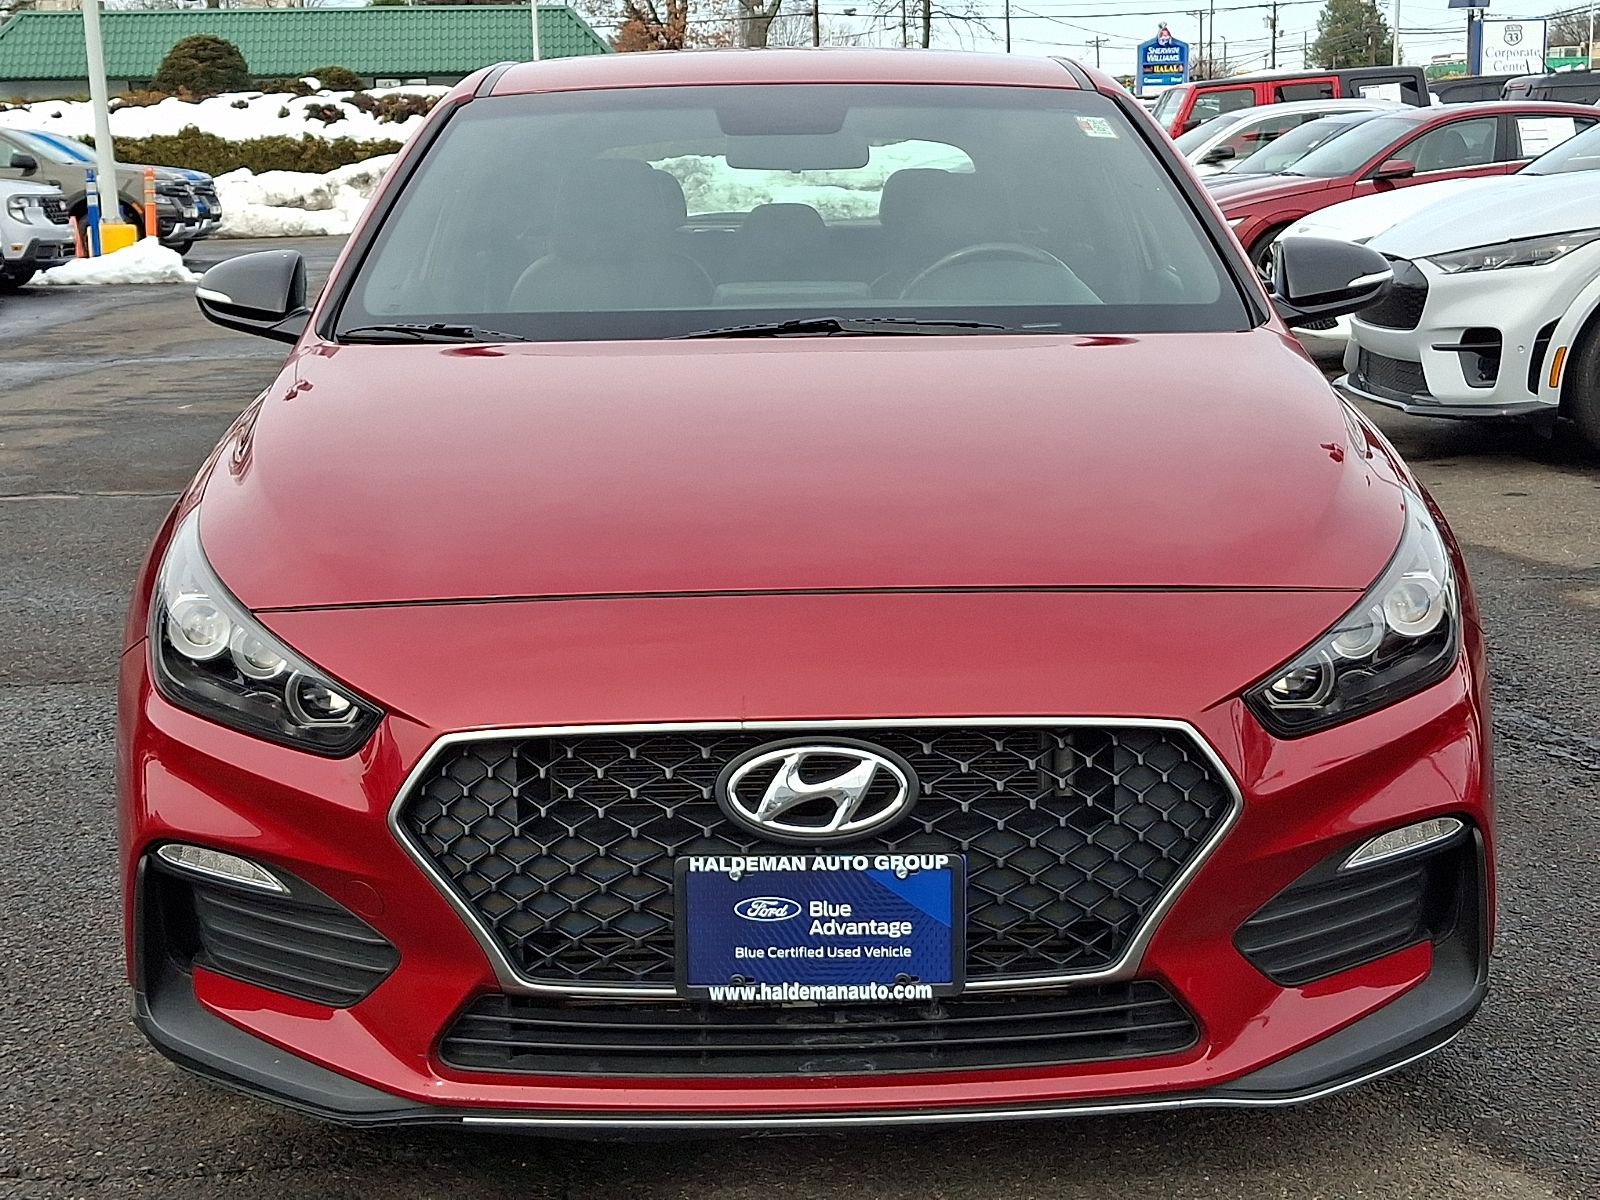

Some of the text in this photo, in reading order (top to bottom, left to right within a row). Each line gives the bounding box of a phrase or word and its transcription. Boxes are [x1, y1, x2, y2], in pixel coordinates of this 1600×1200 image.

[1507, 32, 1519, 42] 33
[1147, 54, 1180, 62] WILLIAMS
[1485, 46, 1540, 61] Corporate
[1153, 65, 1178, 73] HALAL
[689, 854, 949, 872] HALDEMAN AUTO GROUP
[746, 900, 790, 918] Ford
[809, 901, 852, 917] Blue
[808, 919, 912, 938] Advantage
[735, 946, 912, 959] Blue Certified Used Vehicle
[708, 982, 933, 1001] www.haldemanauto.com
